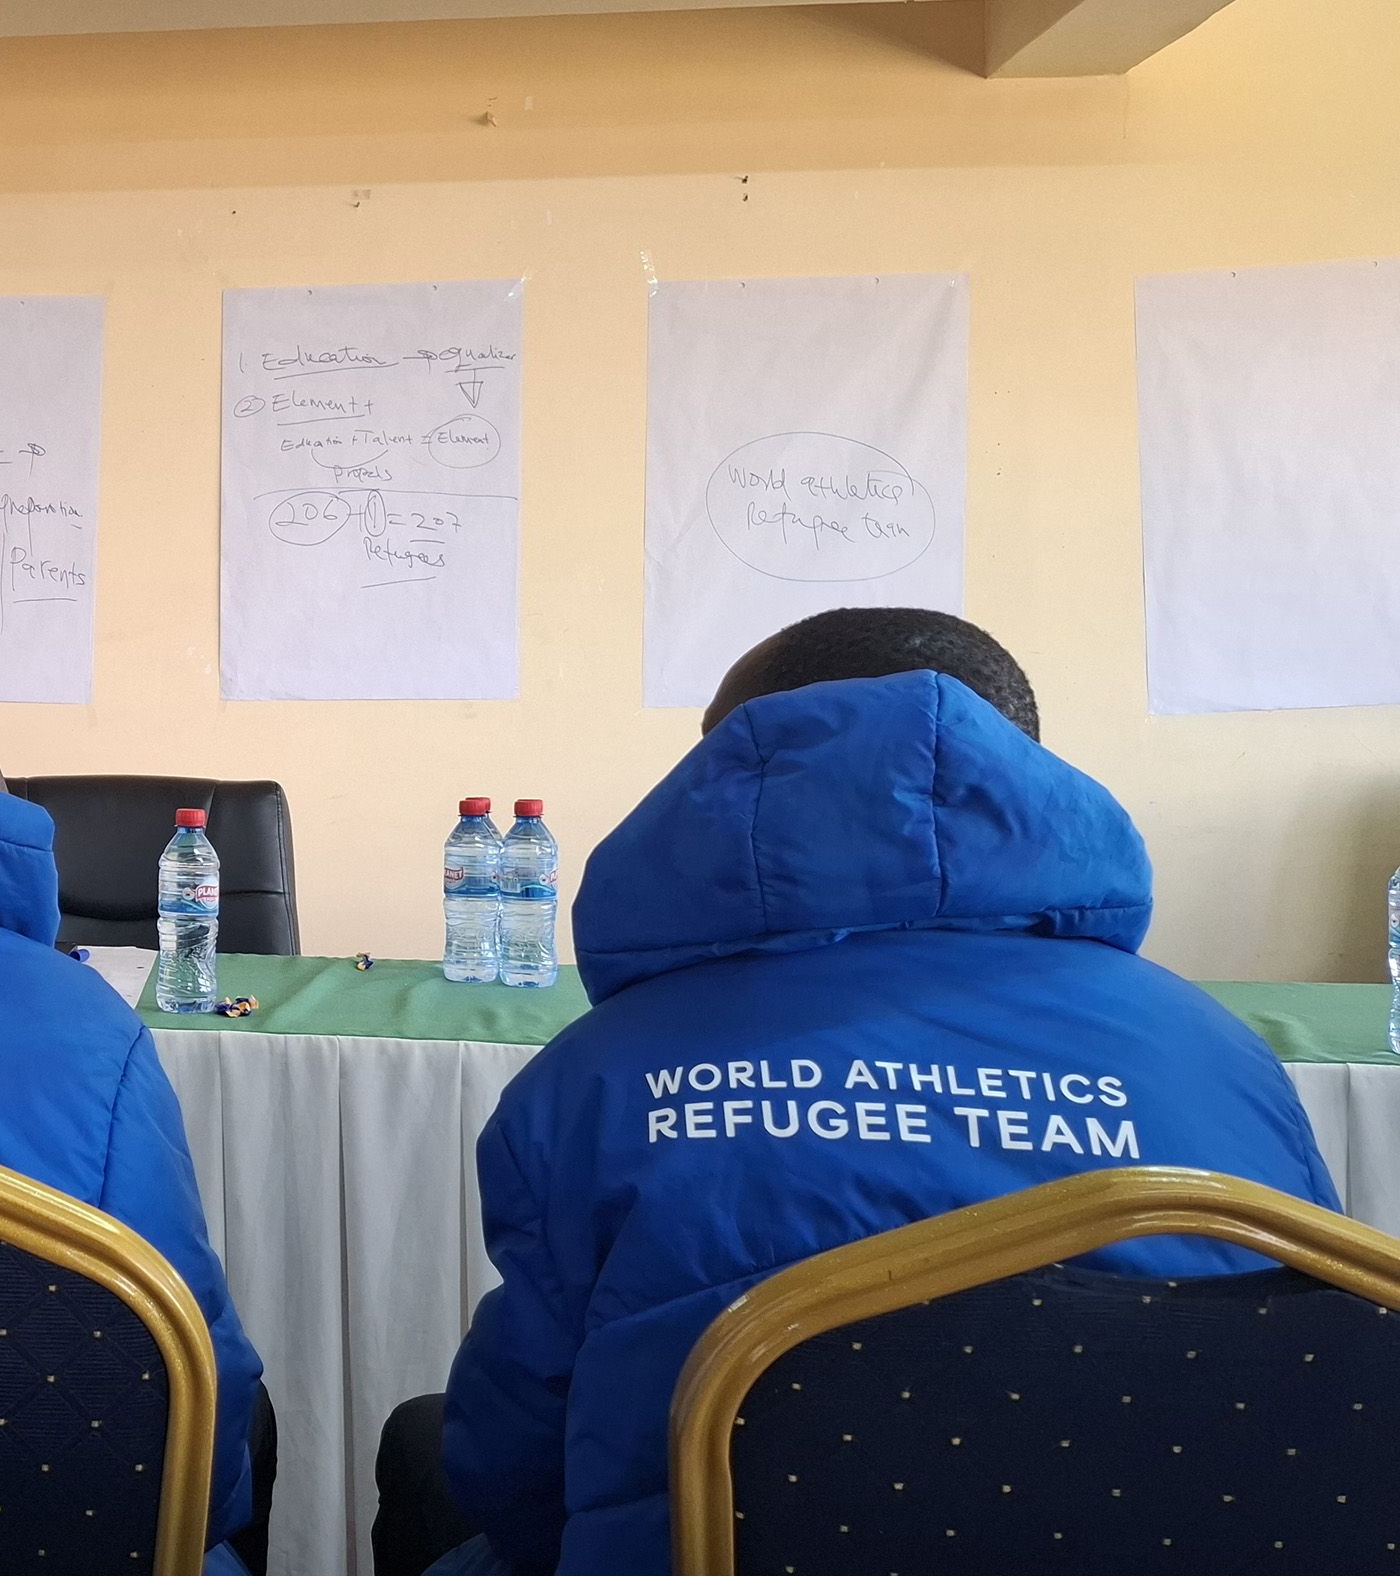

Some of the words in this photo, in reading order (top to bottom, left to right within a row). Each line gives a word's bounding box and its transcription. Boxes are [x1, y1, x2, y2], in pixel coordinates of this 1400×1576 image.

[275, 497, 339, 527] 206
[411, 511, 463, 533] 207
[645, 1058, 822, 1099] WORLD
[844, 1059, 1128, 1107] ATHLETICS
[647, 1100, 932, 1143] REFUGEE
[954, 1107, 1140, 1159] TEAM
